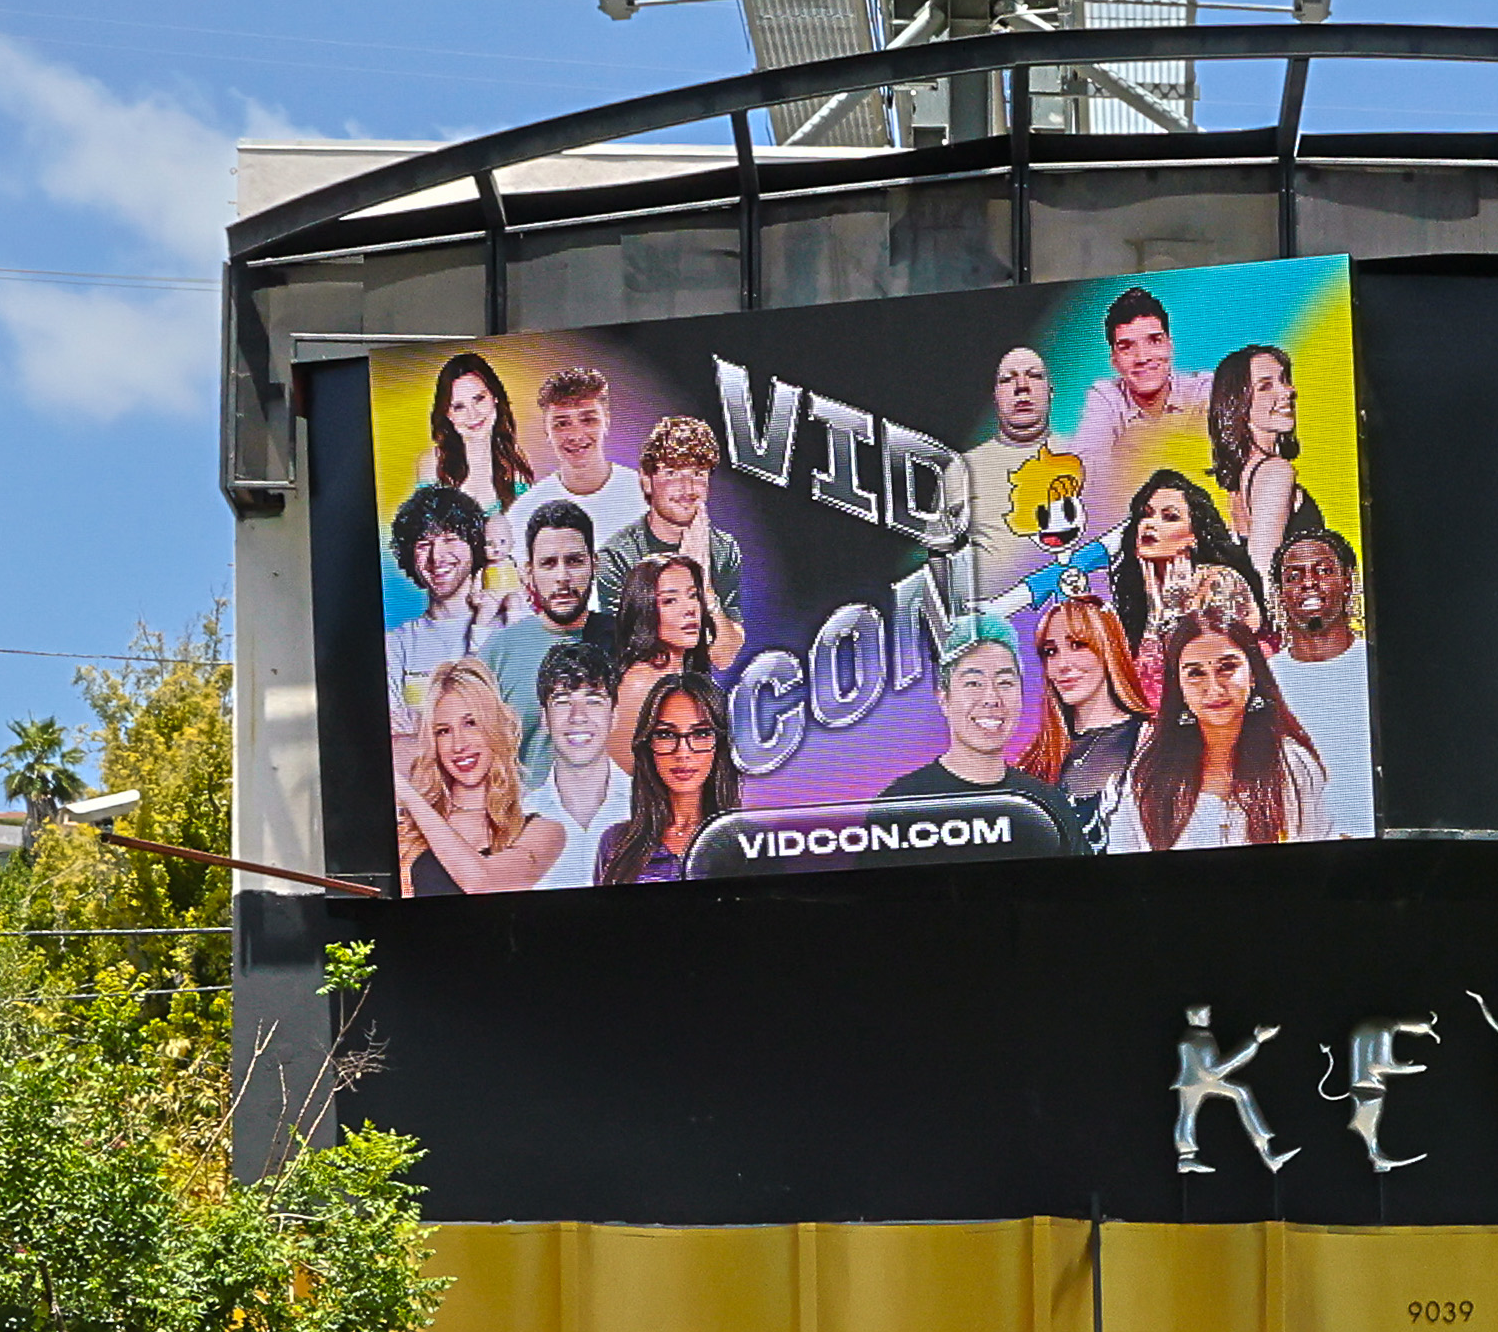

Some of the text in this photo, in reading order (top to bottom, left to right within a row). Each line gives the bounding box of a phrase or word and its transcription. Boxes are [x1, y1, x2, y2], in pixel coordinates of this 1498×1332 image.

[711, 352, 970, 551] VID
[728, 549, 978, 775] CON
[737, 816, 1012, 859] VIDCON.COM
[1408, 1300, 1474, 1324] 9039
